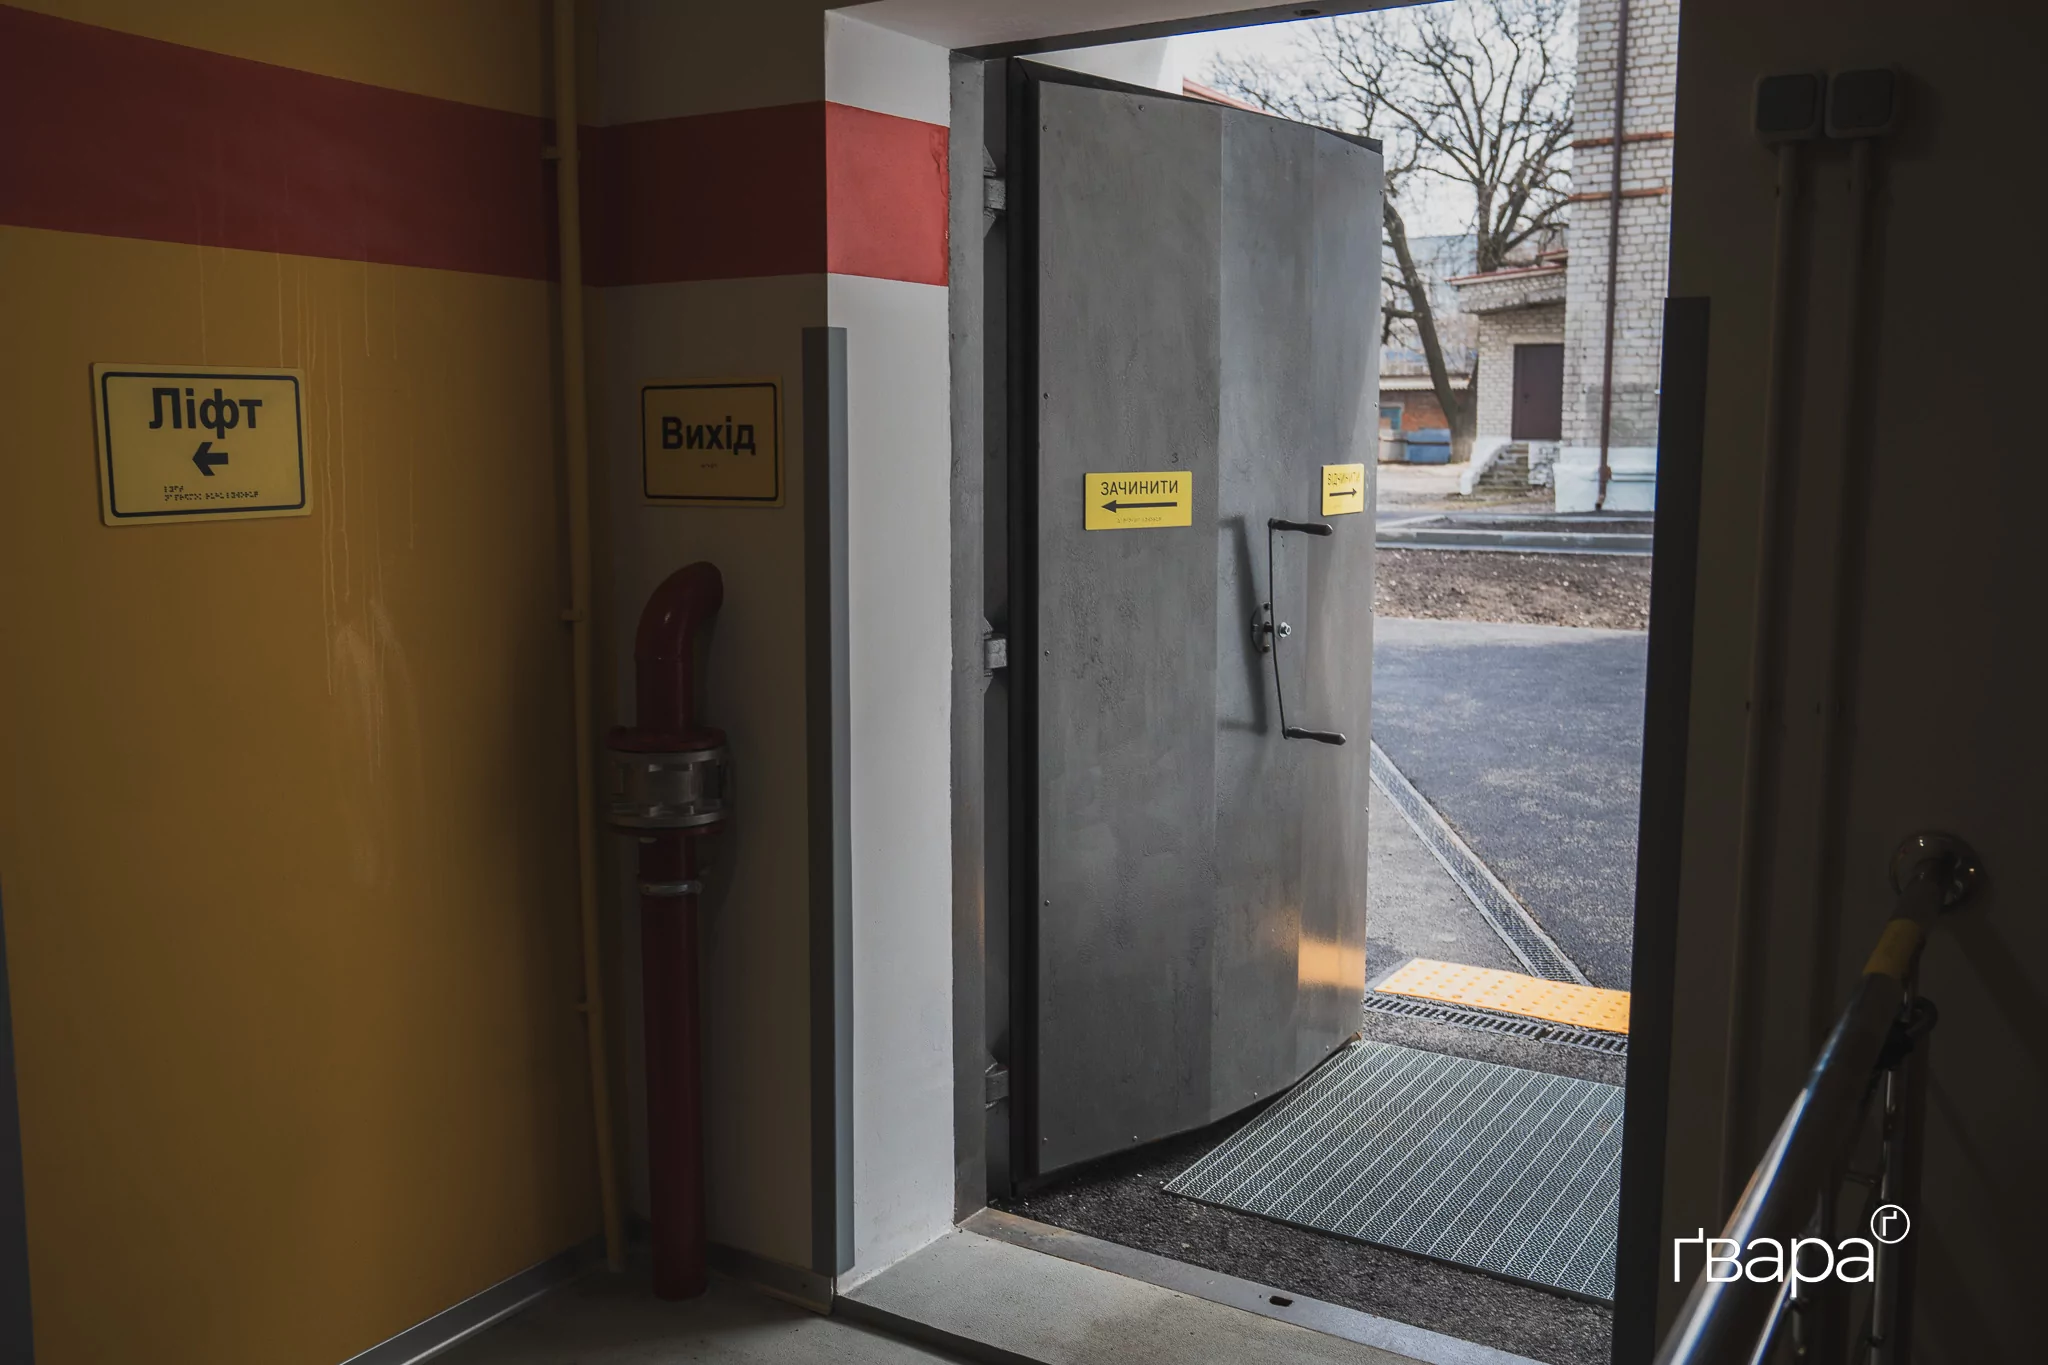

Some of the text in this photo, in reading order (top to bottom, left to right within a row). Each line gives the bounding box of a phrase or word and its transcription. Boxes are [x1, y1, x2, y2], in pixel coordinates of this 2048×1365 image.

[149, 387, 263, 439] Ліфт
[661, 415, 756, 456] Вихід
[1100, 480, 1179, 496] ЗАЧИНИТИ
